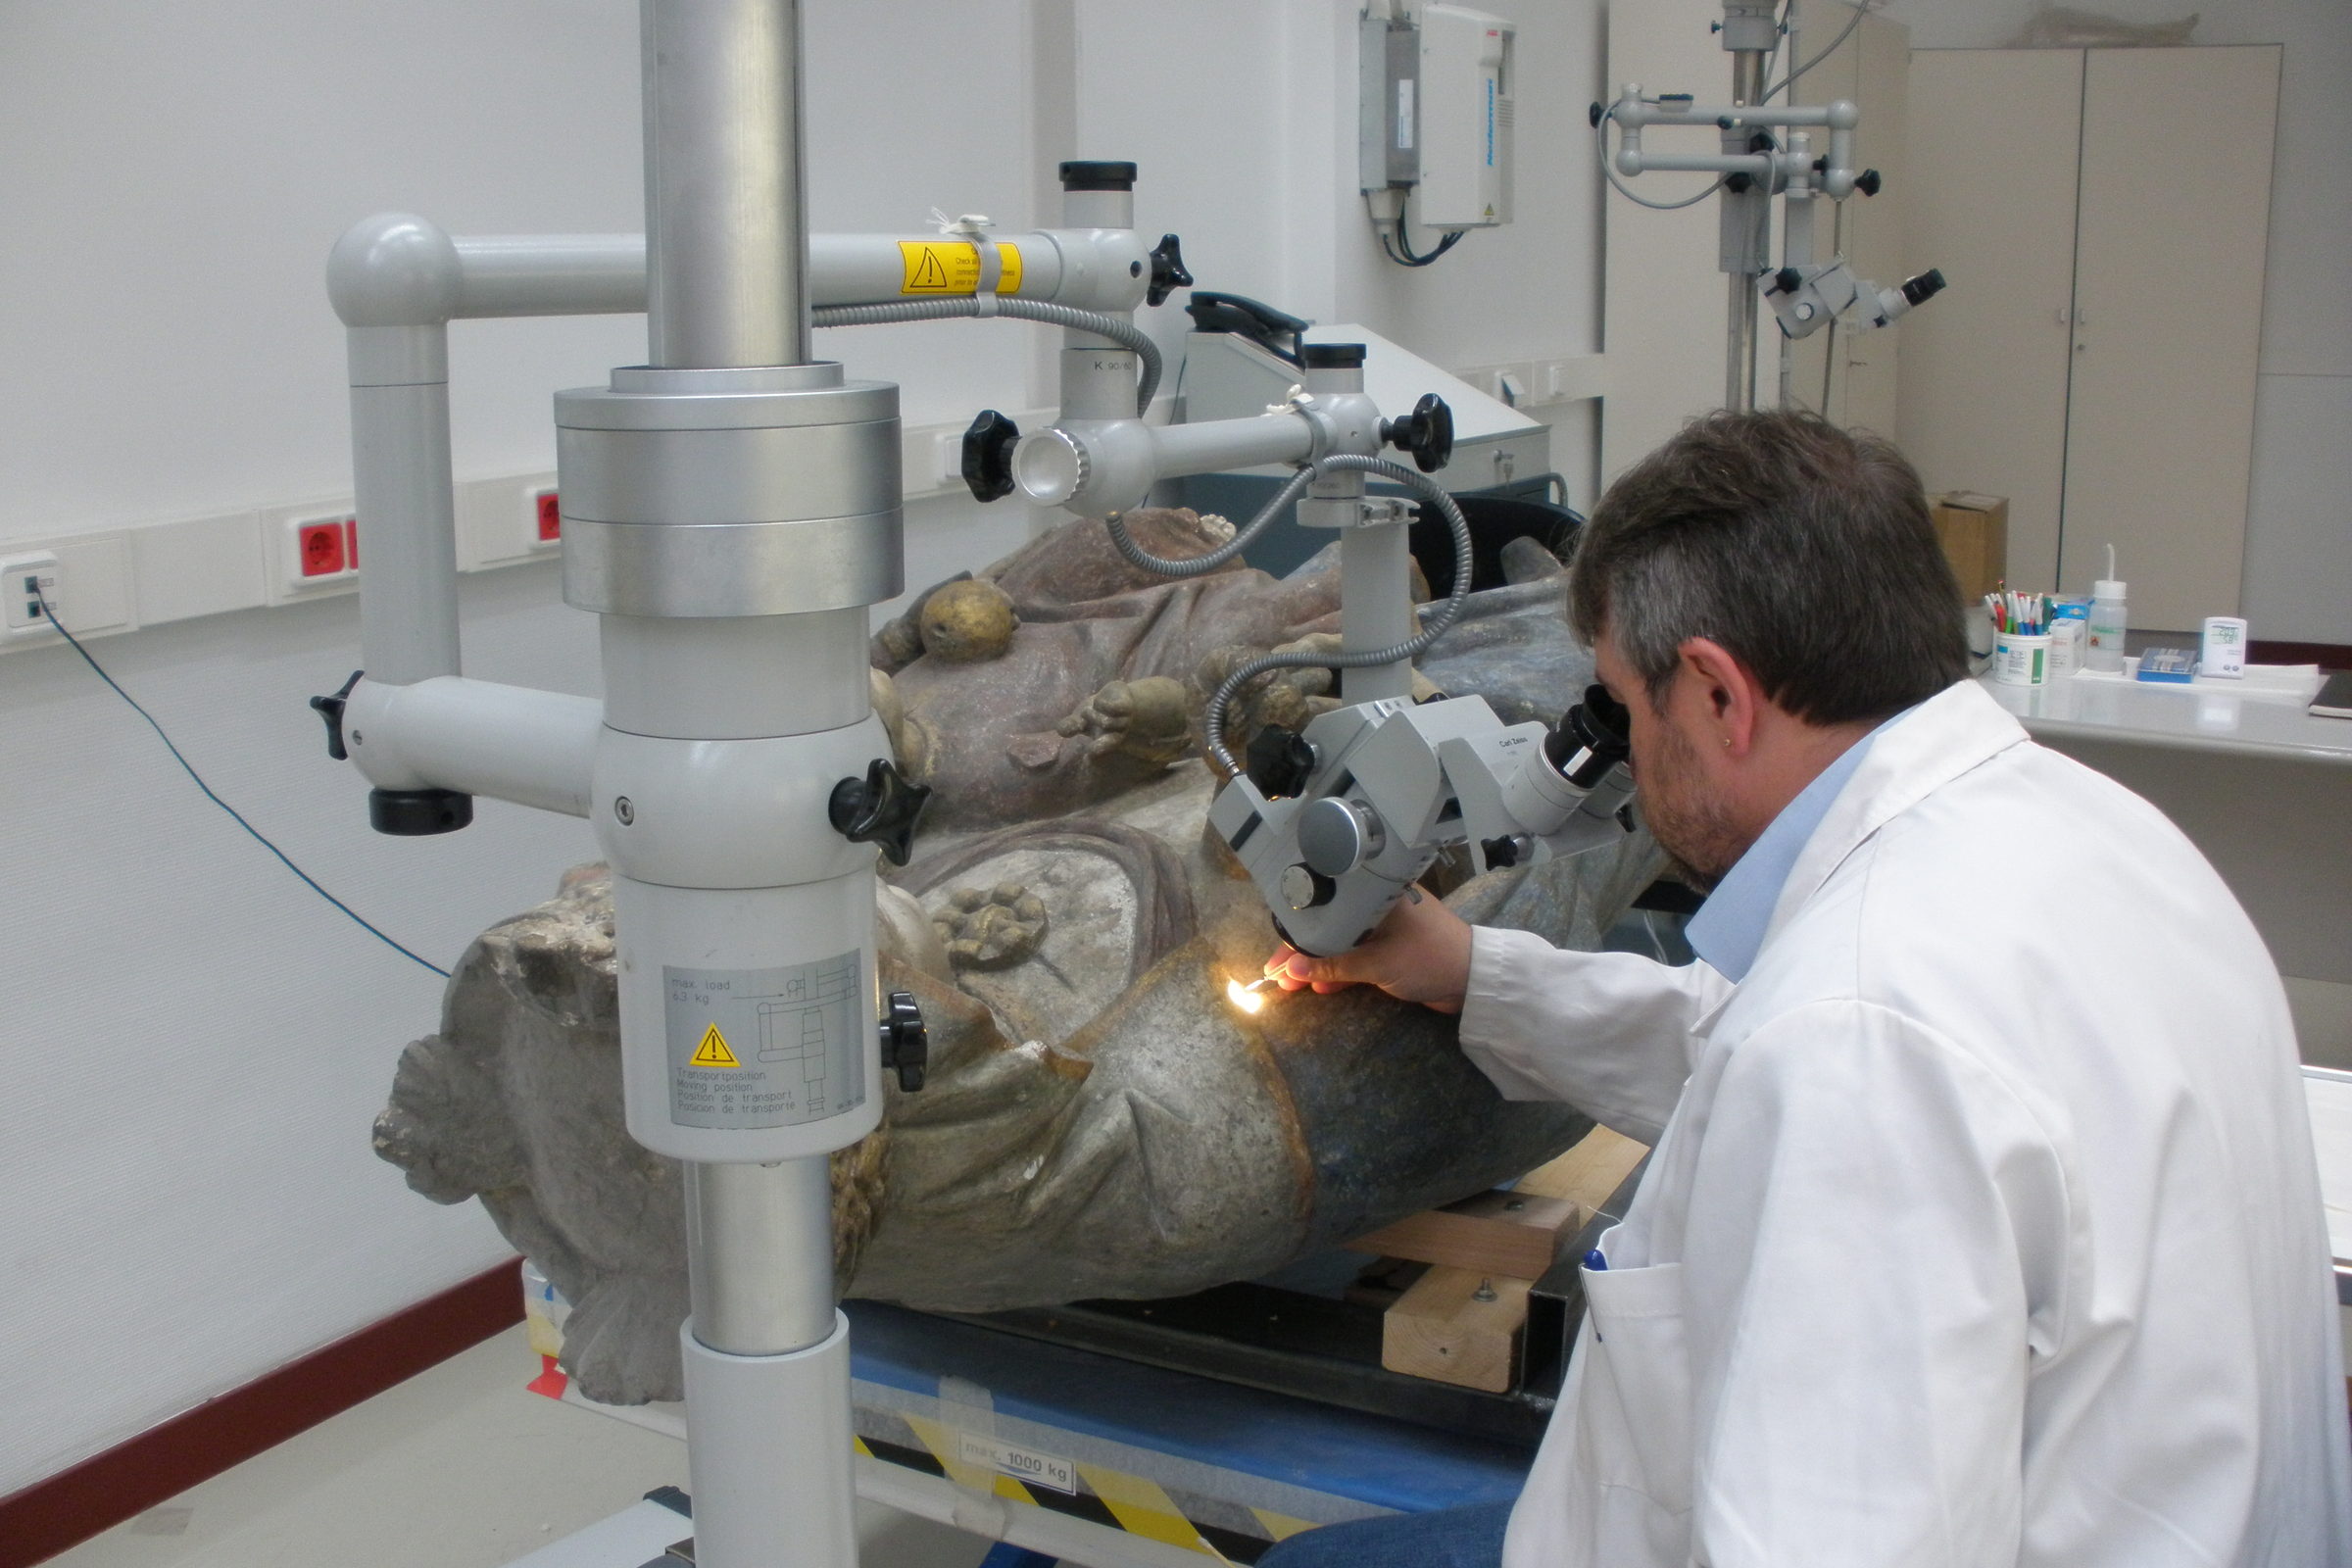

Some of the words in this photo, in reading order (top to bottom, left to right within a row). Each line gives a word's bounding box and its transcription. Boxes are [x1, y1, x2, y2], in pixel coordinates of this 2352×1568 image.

[1095, 362, 1102, 370] K
[706, 980, 730, 990] load
[695, 994, 709, 1005] kg
[676, 1067, 766, 1082] Transportposition
[677, 1079, 708, 1091] Moving
[714, 1082, 753, 1092] position
[677, 1089, 714, 1102] Position
[722, 1094, 734, 1102] de
[743, 1090, 792, 1102] transport
[722, 1104, 734, 1113] de
[742, 1102, 796, 1114] transporte
[966, 1444, 1001, 1461] max.
[1007, 1451, 1042, 1472] 1000
[1049, 1462, 1067, 1483] kg
